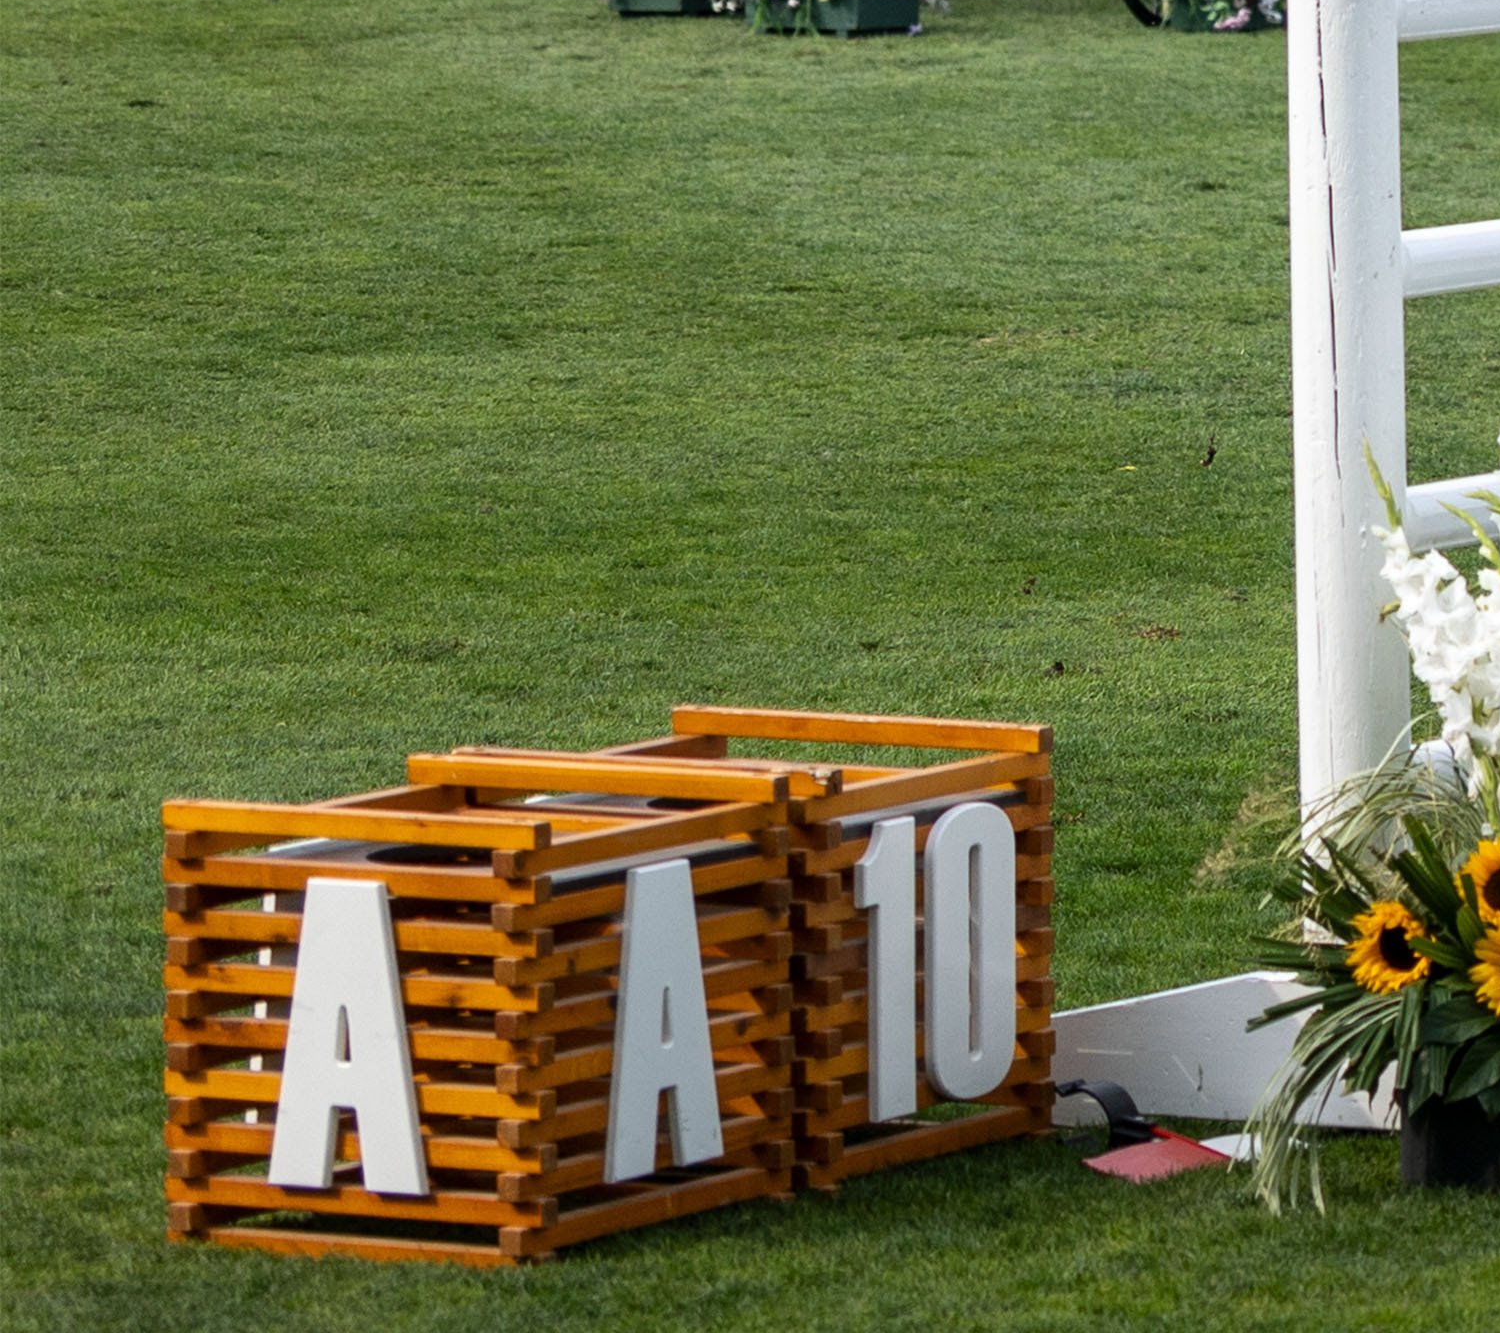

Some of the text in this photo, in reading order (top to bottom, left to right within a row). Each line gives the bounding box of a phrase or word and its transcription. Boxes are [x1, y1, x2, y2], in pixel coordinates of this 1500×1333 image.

[268, 878, 430, 1196] A
[605, 859, 724, 1185] A
[854, 802, 1017, 1123] 10
